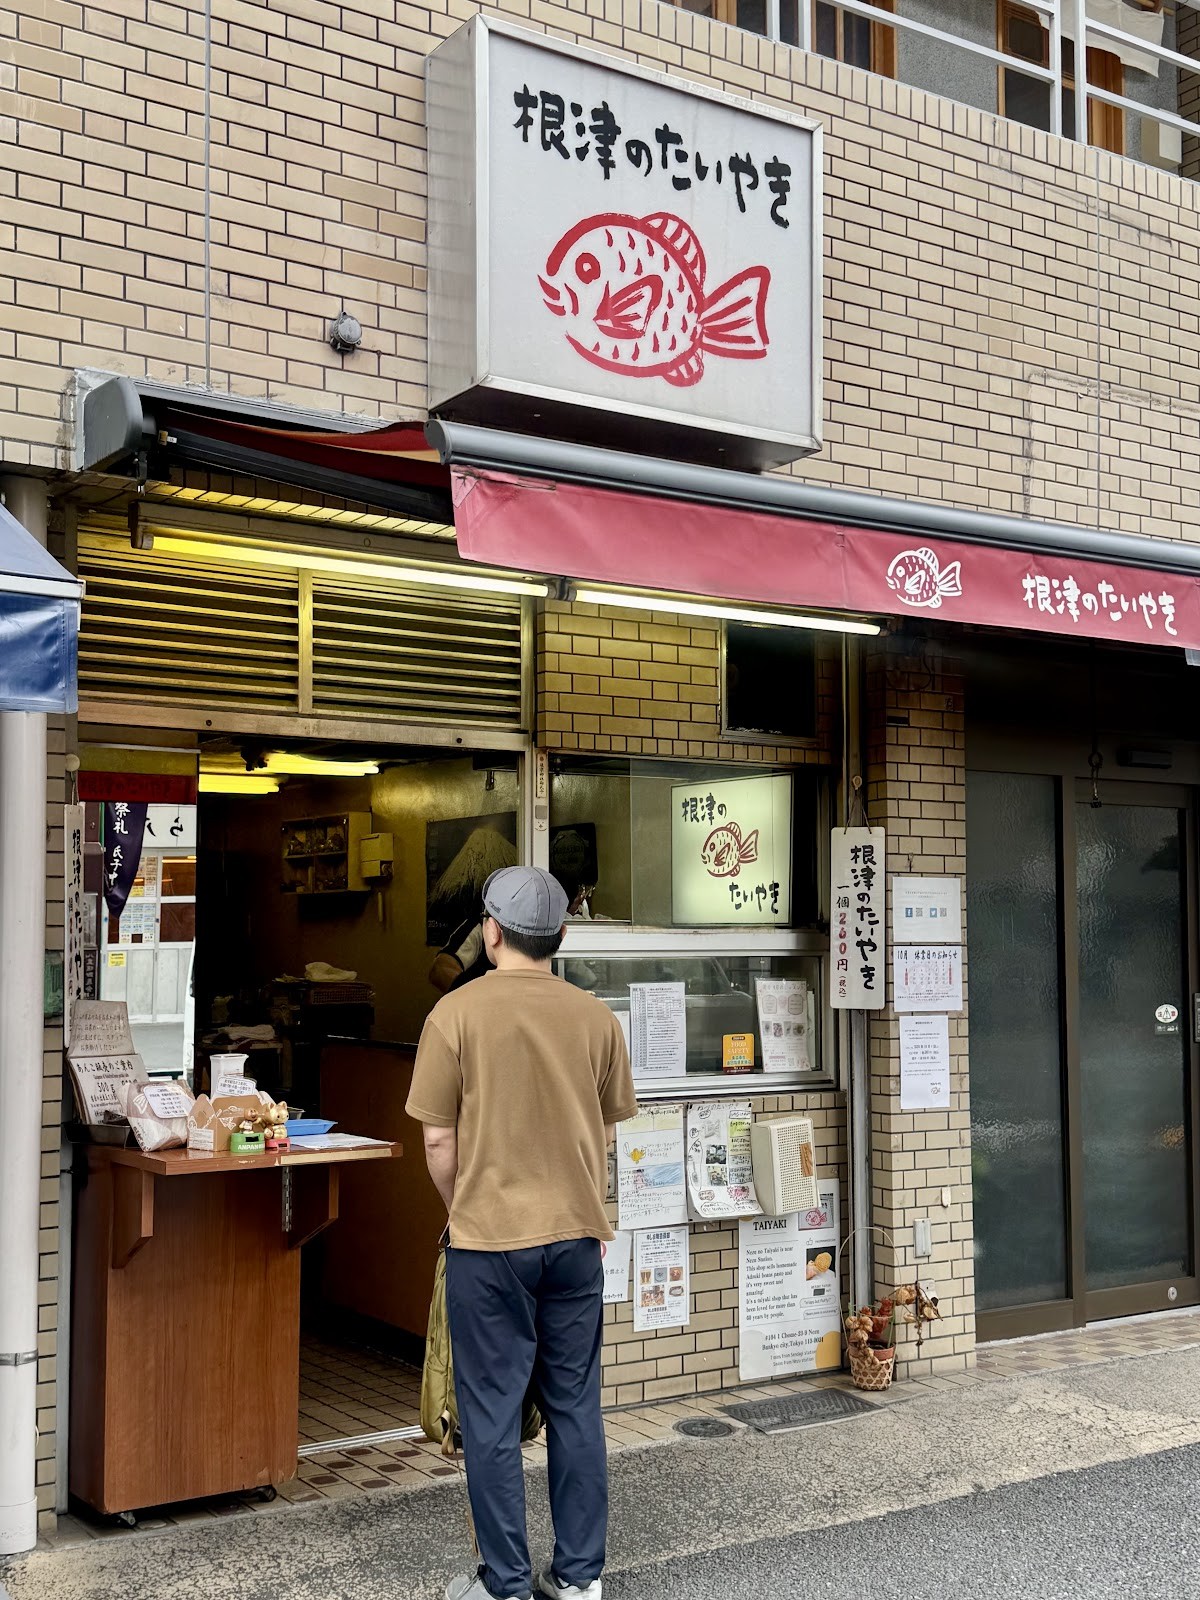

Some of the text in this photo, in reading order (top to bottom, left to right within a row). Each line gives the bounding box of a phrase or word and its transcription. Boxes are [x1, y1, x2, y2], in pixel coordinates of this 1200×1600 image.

[512, 84, 792, 229] 根津のたいやき
[1022, 573, 1178, 636] 根津のたいやき
[682, 793, 727, 825] 根津の
[729, 880, 780, 914] たいやき
[850, 845, 880, 990] 根津のたいやき
[753, 1219, 787, 1231] TAIYAKI
